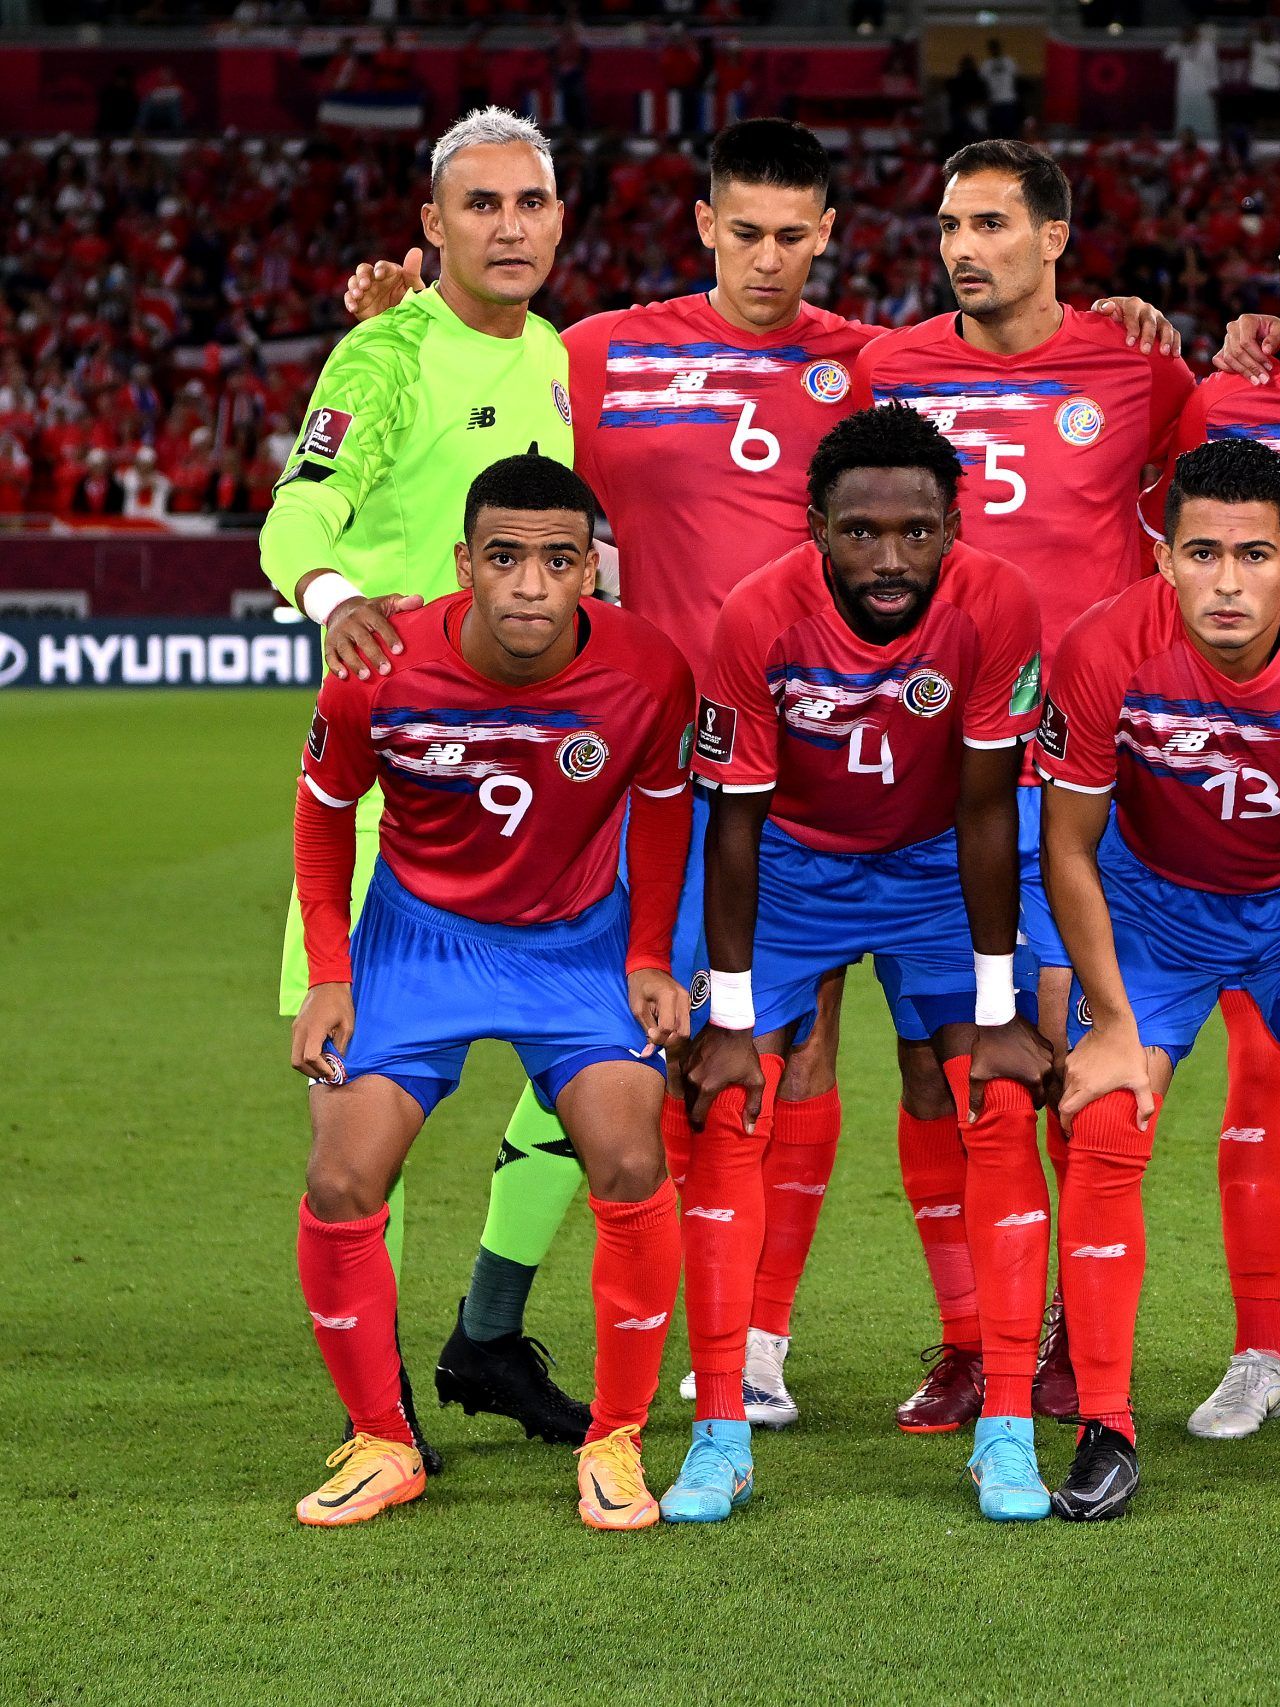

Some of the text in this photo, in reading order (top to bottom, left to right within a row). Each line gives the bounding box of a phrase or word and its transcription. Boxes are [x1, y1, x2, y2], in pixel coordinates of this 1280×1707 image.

[730, 401, 780, 472] 6
[984, 444, 1026, 514] 5
[38, 634, 311, 684] HYUNDAI
[848, 727, 895, 784] 4
[479, 775, 533, 837] 9
